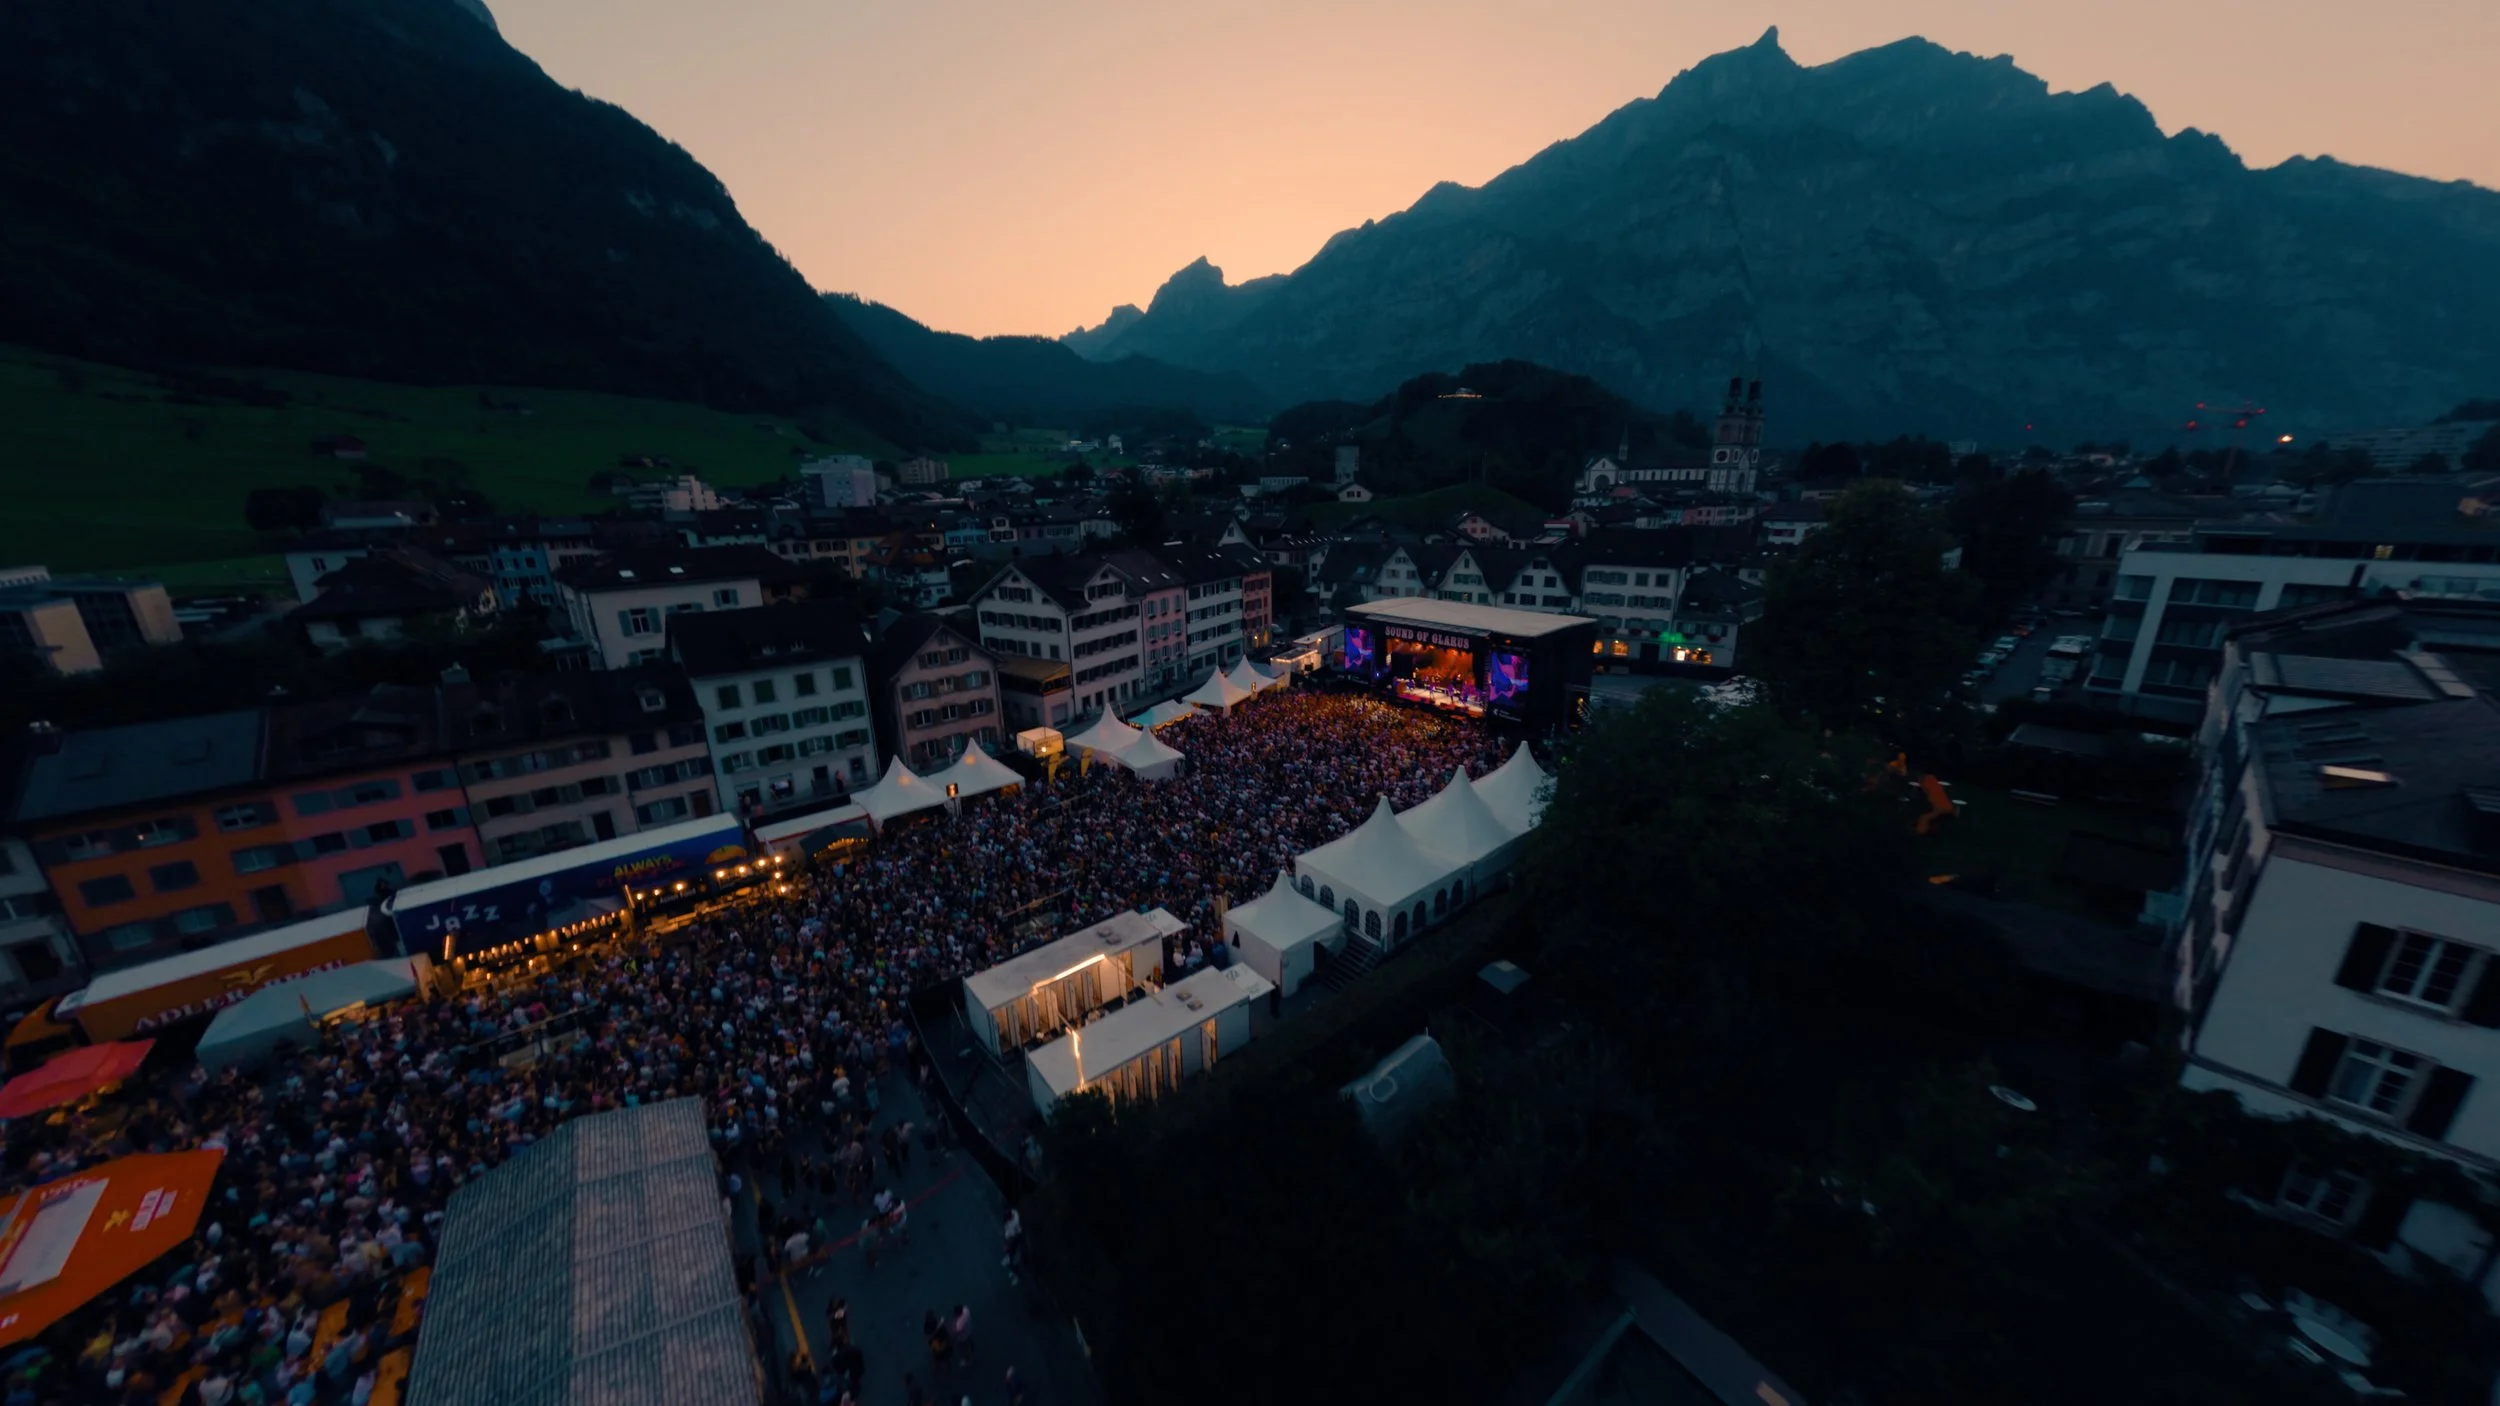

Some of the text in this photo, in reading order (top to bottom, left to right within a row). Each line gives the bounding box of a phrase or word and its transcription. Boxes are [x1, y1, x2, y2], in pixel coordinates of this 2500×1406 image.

[1385, 625, 1470, 649] SOUND OF GLARUS
